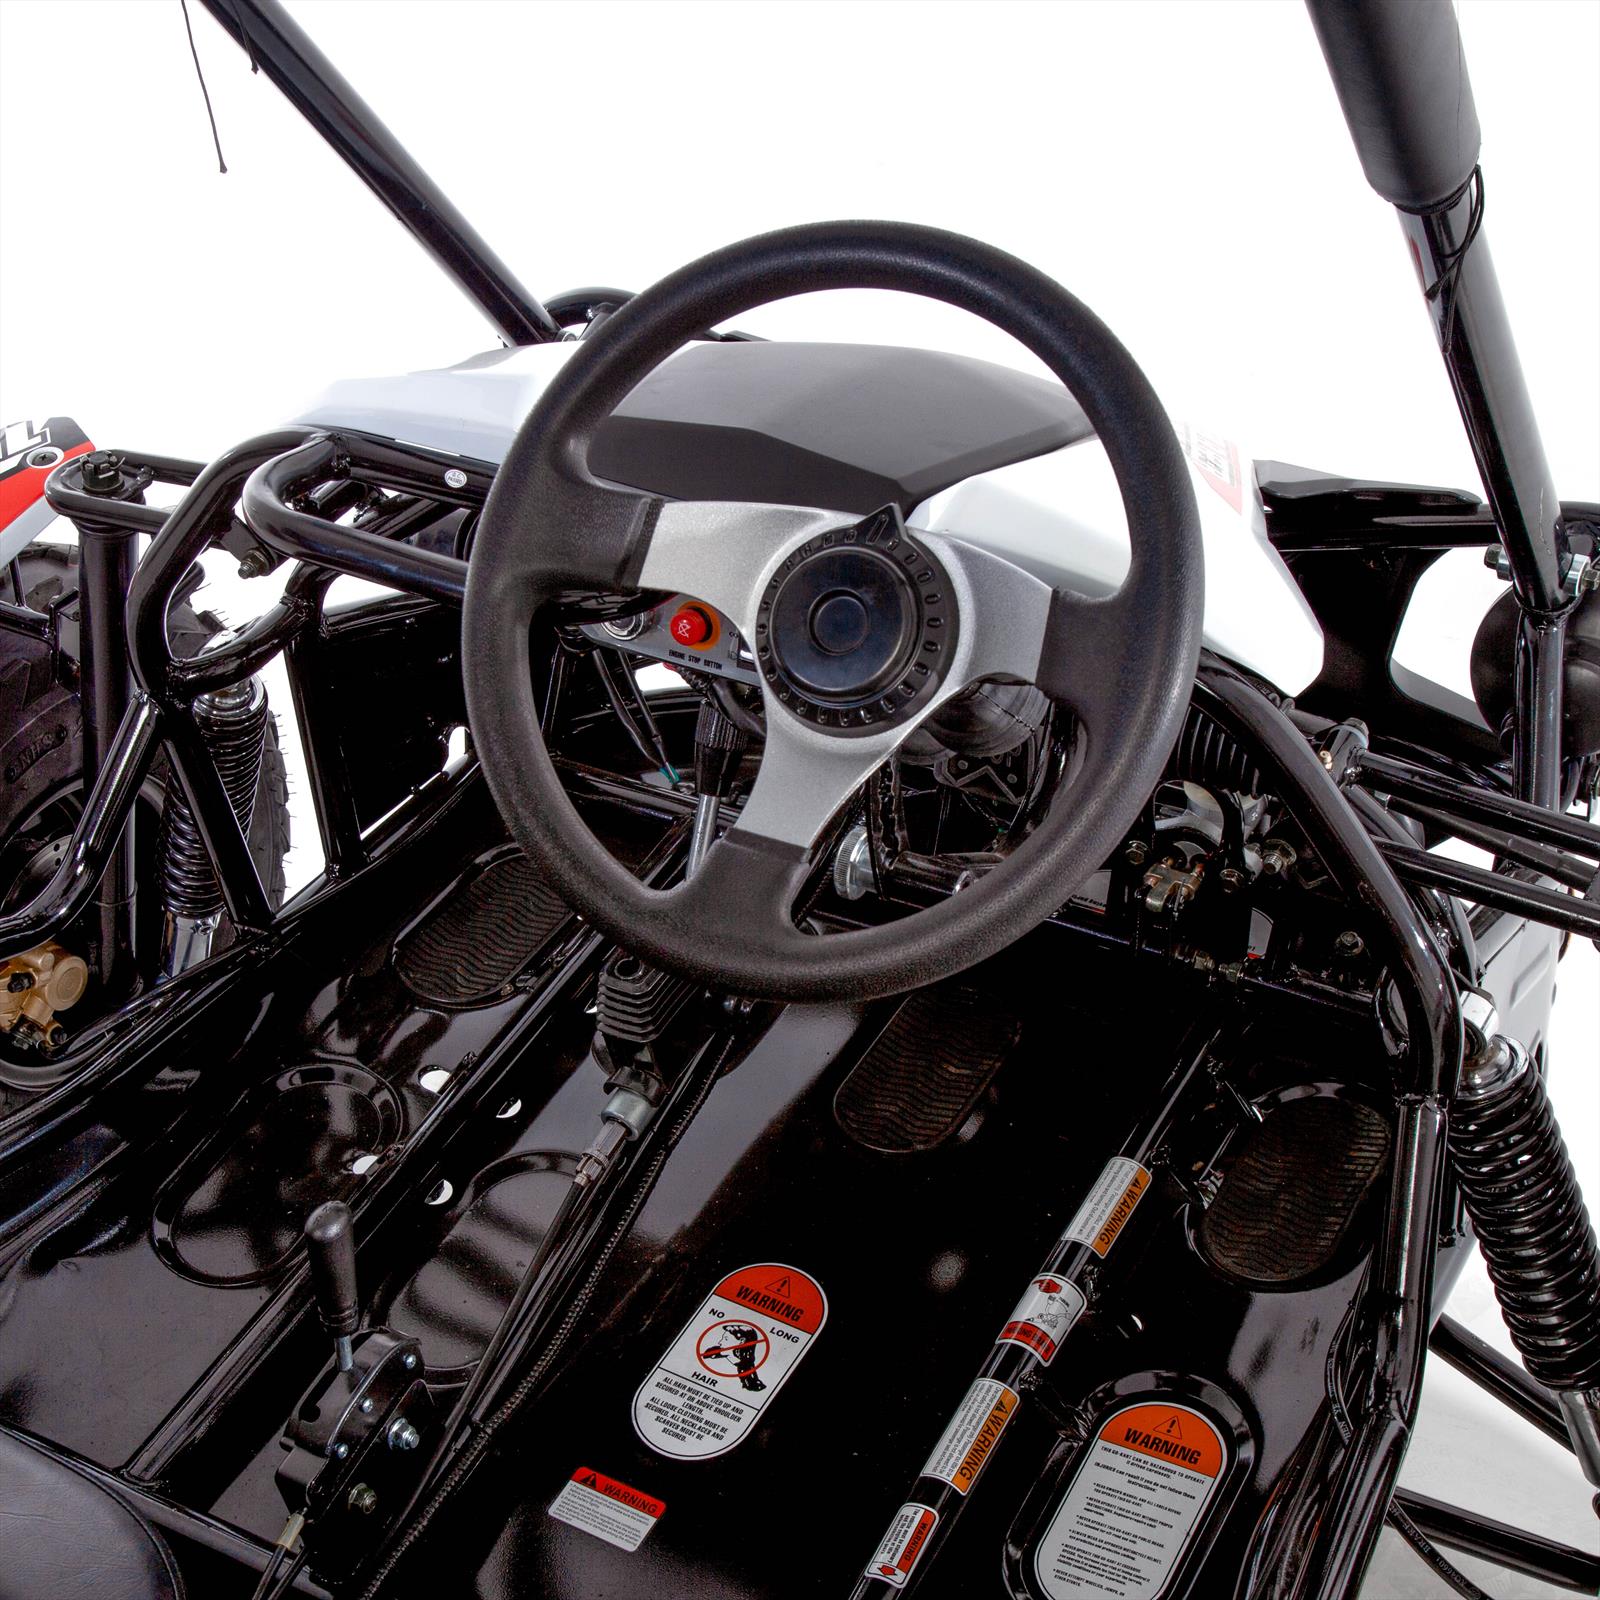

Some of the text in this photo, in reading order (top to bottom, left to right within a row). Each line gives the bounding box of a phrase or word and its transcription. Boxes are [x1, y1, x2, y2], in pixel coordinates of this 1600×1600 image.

[668, 649, 722, 670] ENGINE STOP BUTTON
[1099, 1190, 1139, 1245] WARNING
[708, 1308, 725, 1319] NO
[736, 1285, 805, 1322] WARNING
[769, 1327, 799, 1344] LONG
[663, 1377, 743, 1415] ALL HAIR MUST BE TIED UP AND
[691, 1371, 719, 1388] HAIR
[651, 1396, 660, 1404] ALL
[660, 1400, 677, 1412] LOOSE
[678, 1408, 704, 1423] CLOTHING
[704, 1419, 720, 1430] MUST
[655, 1382, 678, 1396] SECURED
[687, 1395, 695, 1403] OR
[696, 1399, 713, 1410] ABOVE
[714, 1406, 741, 1422] SHOULDER
[683, 1402, 704, 1415] LENGTH.
[645, 1402, 723, 1441] SECURED. ALL NECKLACES AND
[655, 1415, 679, 1430] SCARVES
[680, 1426, 696, 1437] MUST
[662, 1427, 687, 1442] SECURED.
[959, 1414, 1004, 1481] WARNING
[1124, 1428, 1202, 1465] WARNING
[1112, 1450, 1132, 1459] GO-KART
[1150, 1462, 1177, 1475] HAZARDOUS
[1185, 1474, 1205, 1484] OPERATE
[603, 1483, 658, 1514] WARNING
[904, 1522, 929, 1561] WARNING
